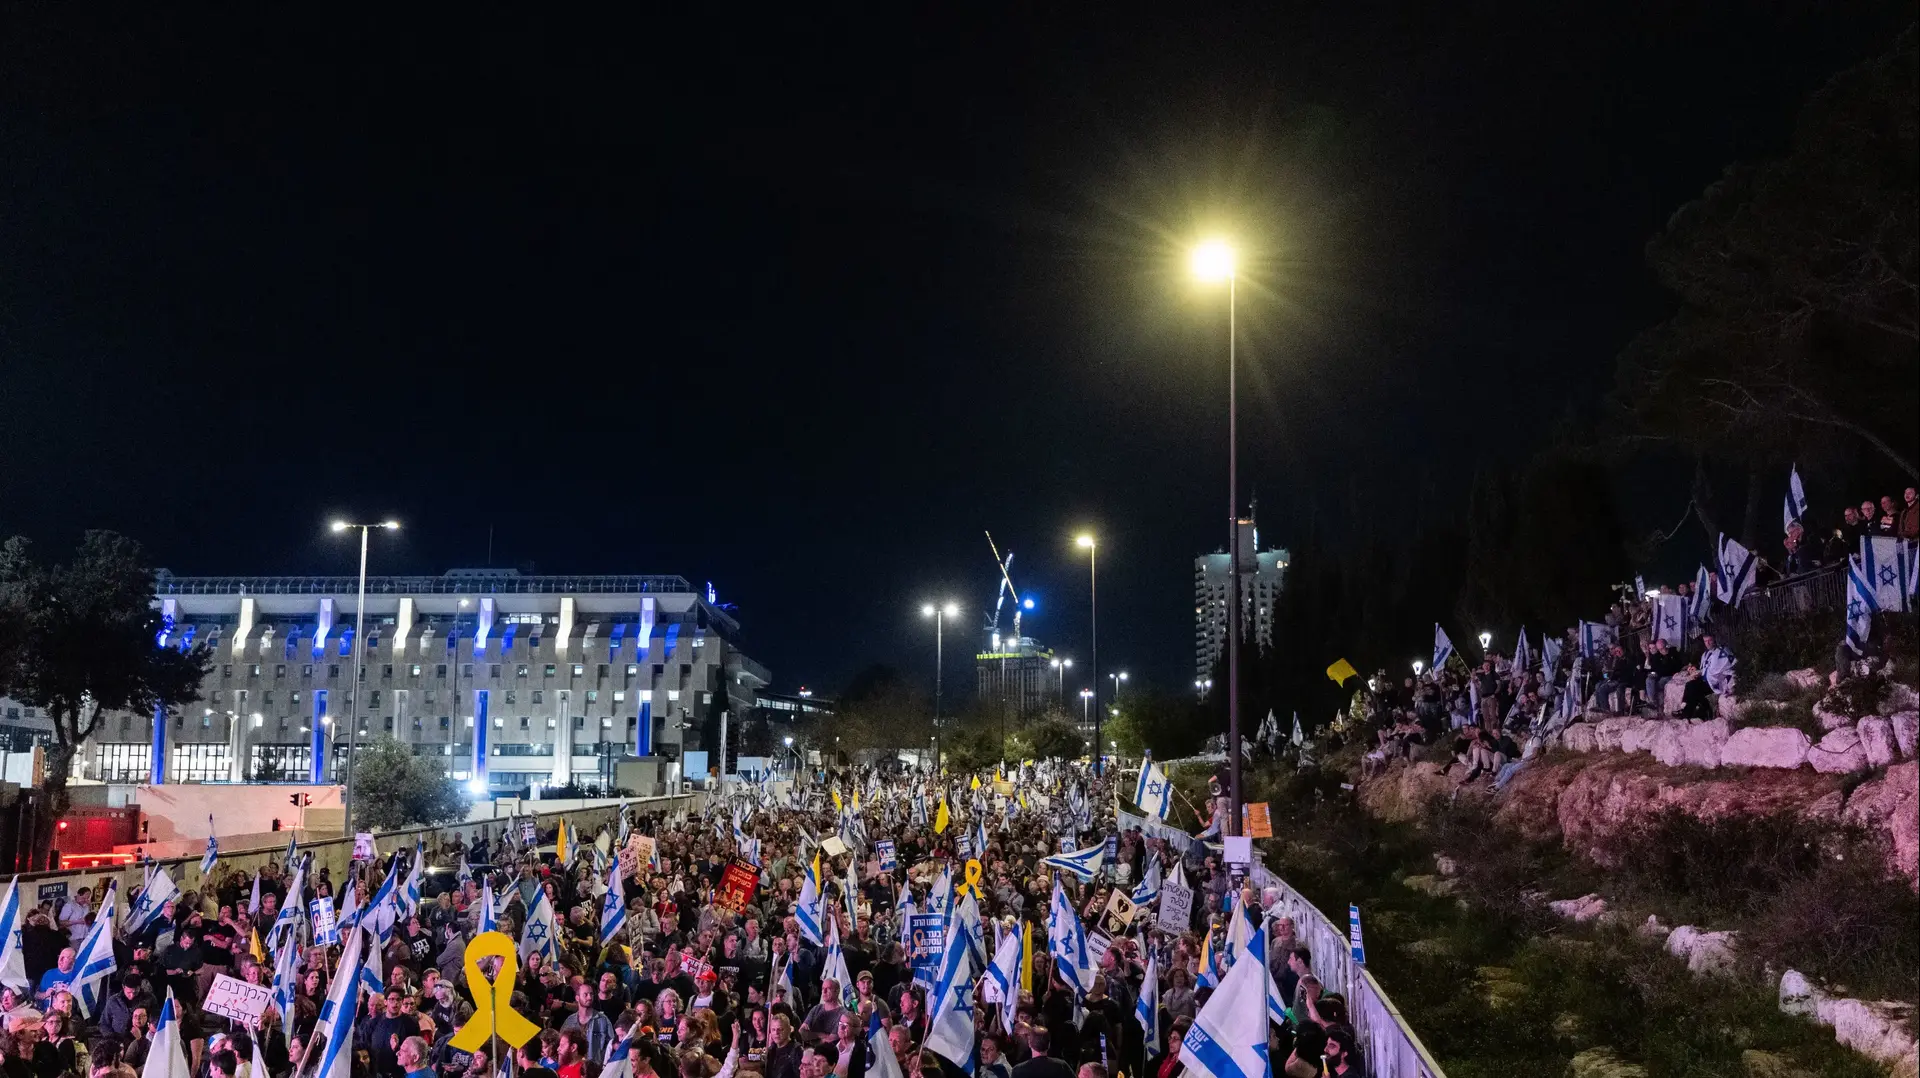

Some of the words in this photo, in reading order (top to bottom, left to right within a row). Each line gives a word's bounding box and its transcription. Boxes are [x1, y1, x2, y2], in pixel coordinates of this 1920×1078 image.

[735, 858, 758, 873] סכנה!
[42, 884, 64, 896] ניצחון
[912, 918, 926, 927] הרוב
[926, 918, 942, 927] אנחנו
[926, 930, 942, 938] בעד
[920, 938, 942, 947] עסקת
[914, 946, 942, 954] חטופים
[218, 979, 269, 1002] המתים
[207, 1001, 259, 1025] מדברים
